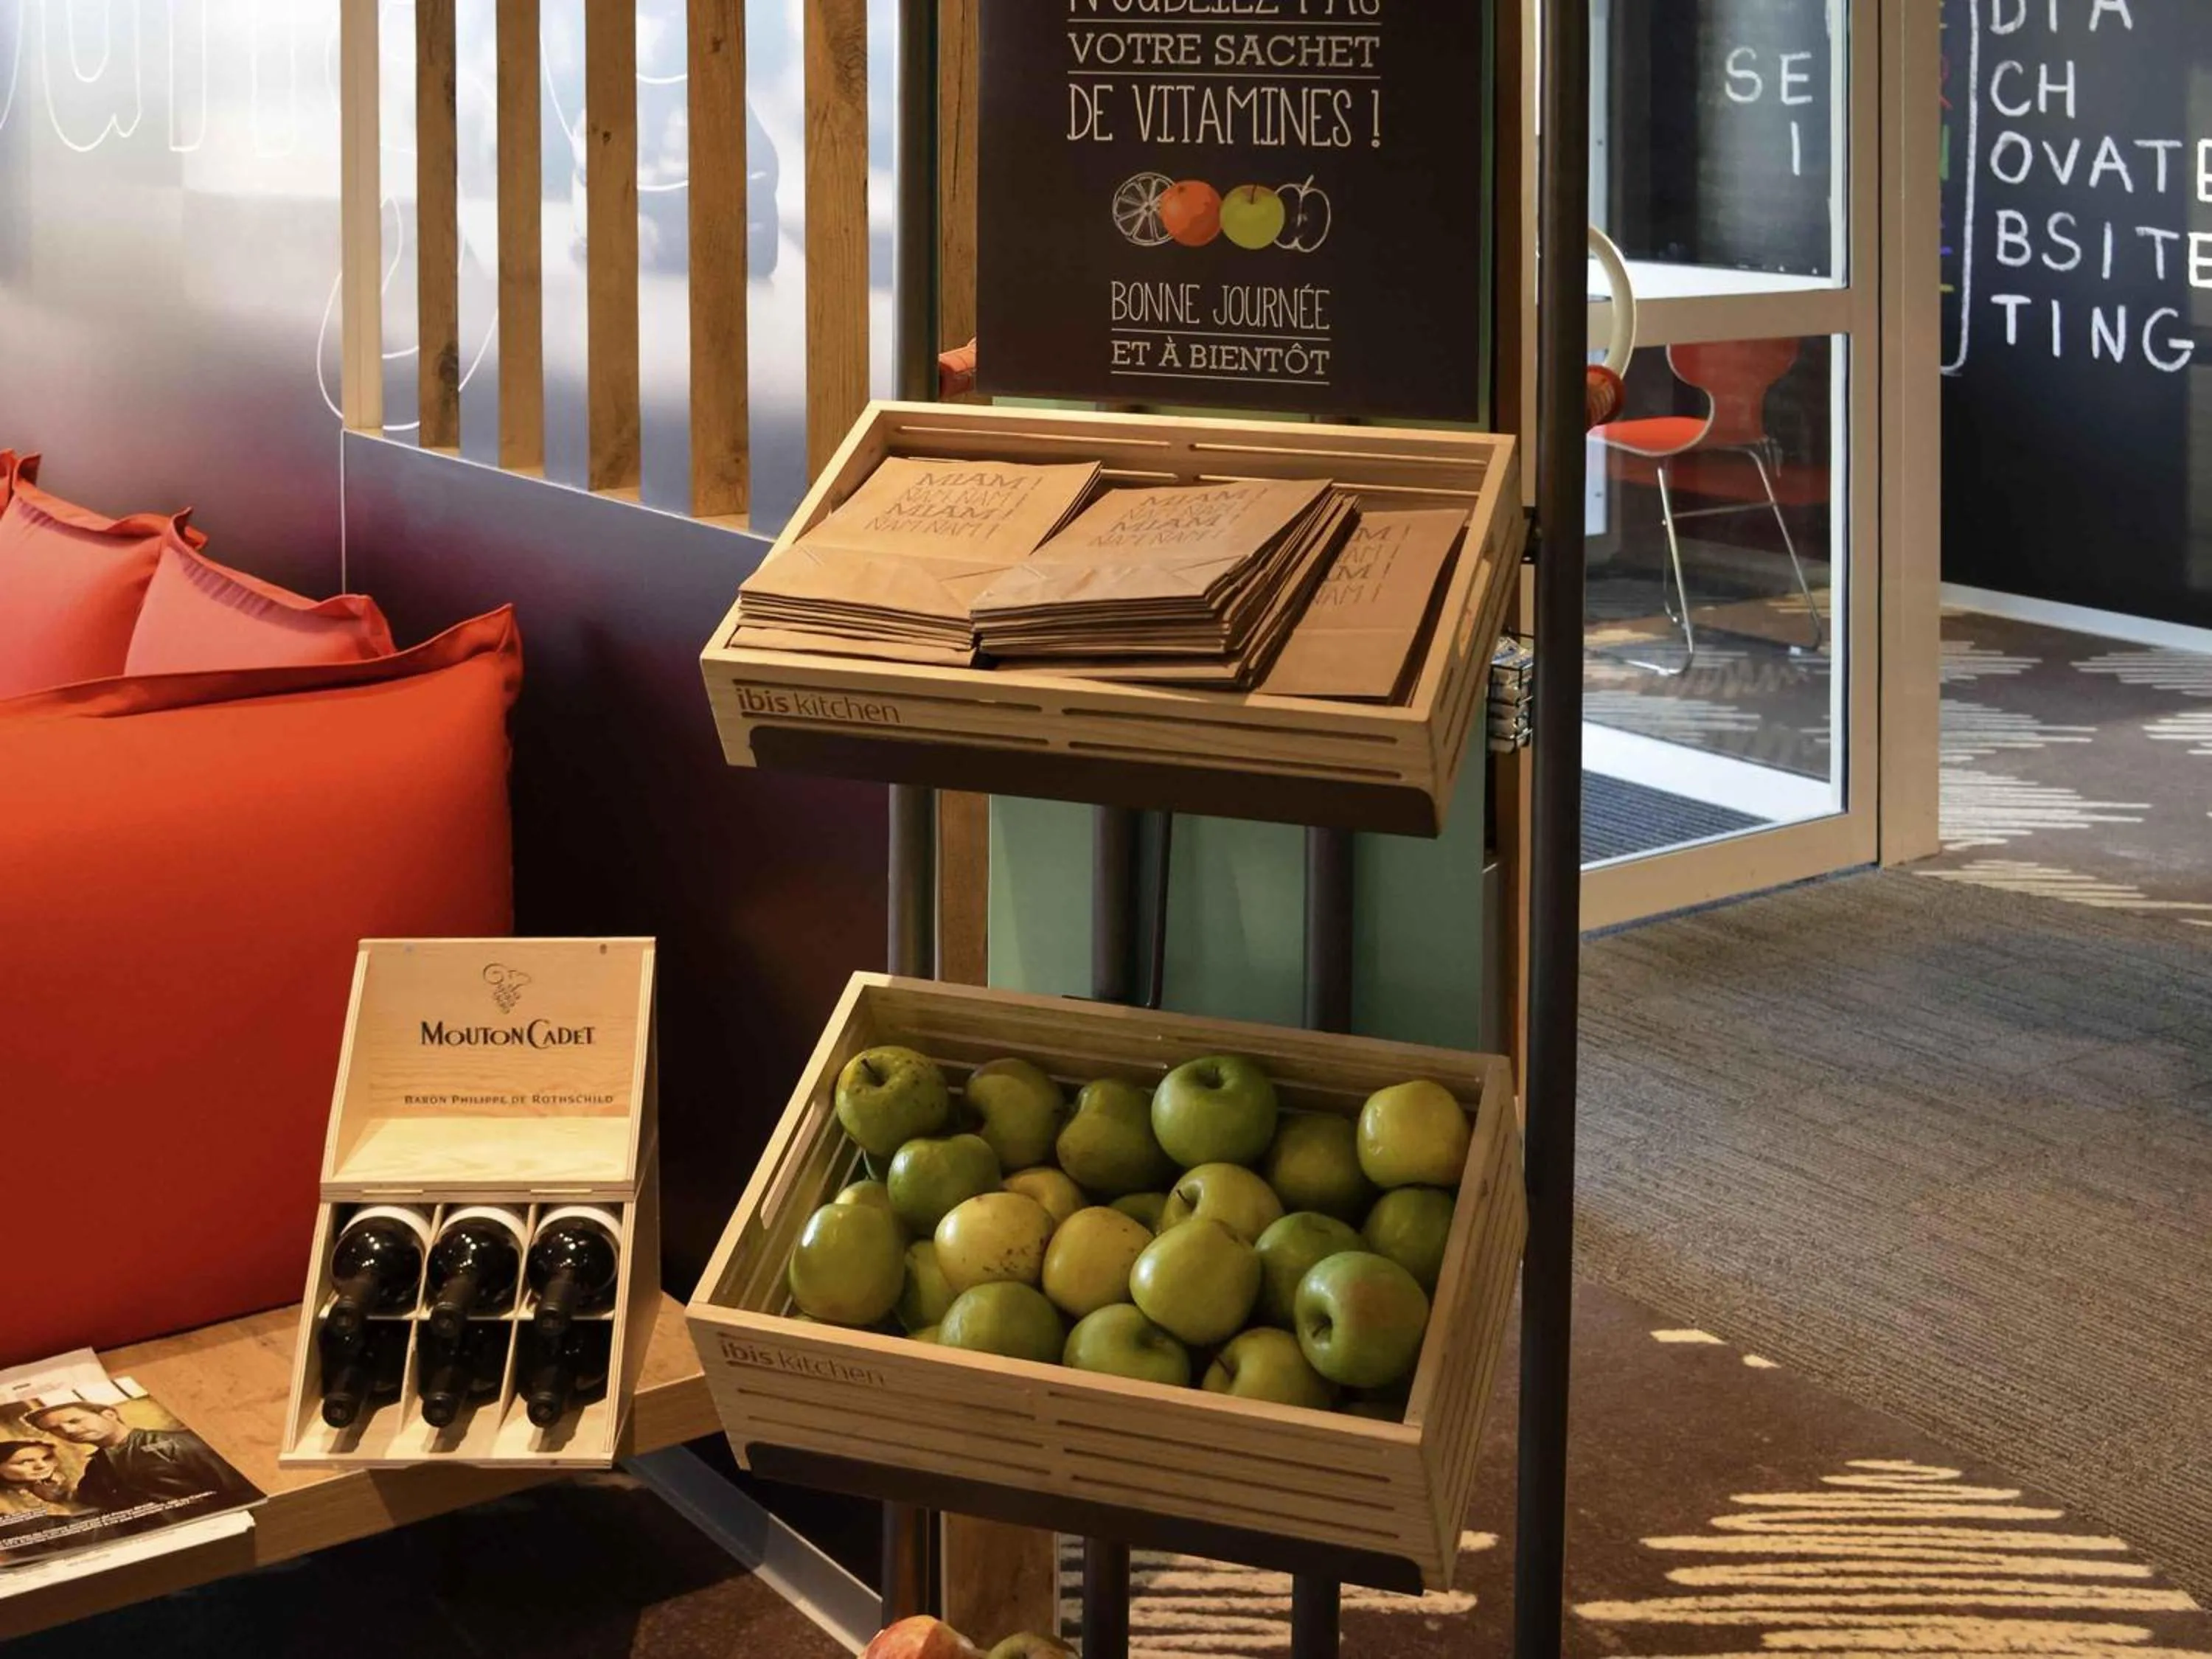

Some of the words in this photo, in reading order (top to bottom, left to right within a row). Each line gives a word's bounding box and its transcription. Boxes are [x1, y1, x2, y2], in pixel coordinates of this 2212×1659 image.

[1068, 32, 1201, 66] VOTRE
[1214, 35, 1380, 68] SACHET
[1724, 46, 1812, 104] SE
[1991, 60, 2076, 119] CH
[1067, 84, 1113, 142] DE
[1132, 84, 1352, 147] VITAMINES
[1371, 88, 1381, 148] !
[1111, 281, 1200, 324] BONNE
[1213, 283, 1330, 330] JOURNÉE
[1991, 294, 2195, 372] TING
[1111, 340, 1150, 366] ET
[1158, 335, 1182, 367] À
[1189, 342, 1330, 375] BIENTÔT
[917, 473, 1028, 490] MIAM
[1140, 488, 1250, 507] MIAM
[885, 502, 1000, 520] MIAM
[1107, 512, 1222, 533] MIAM
[1343, 543, 1383, 563] AM
[736, 687, 789, 714] ibis
[793, 692, 901, 723] kitchen
[404, 1094, 446, 1105] BARON
[532, 1093, 614, 1105] ROTHSCHILD
[722, 1342, 774, 1365] ibis
[778, 1349, 885, 1387] kitchen
